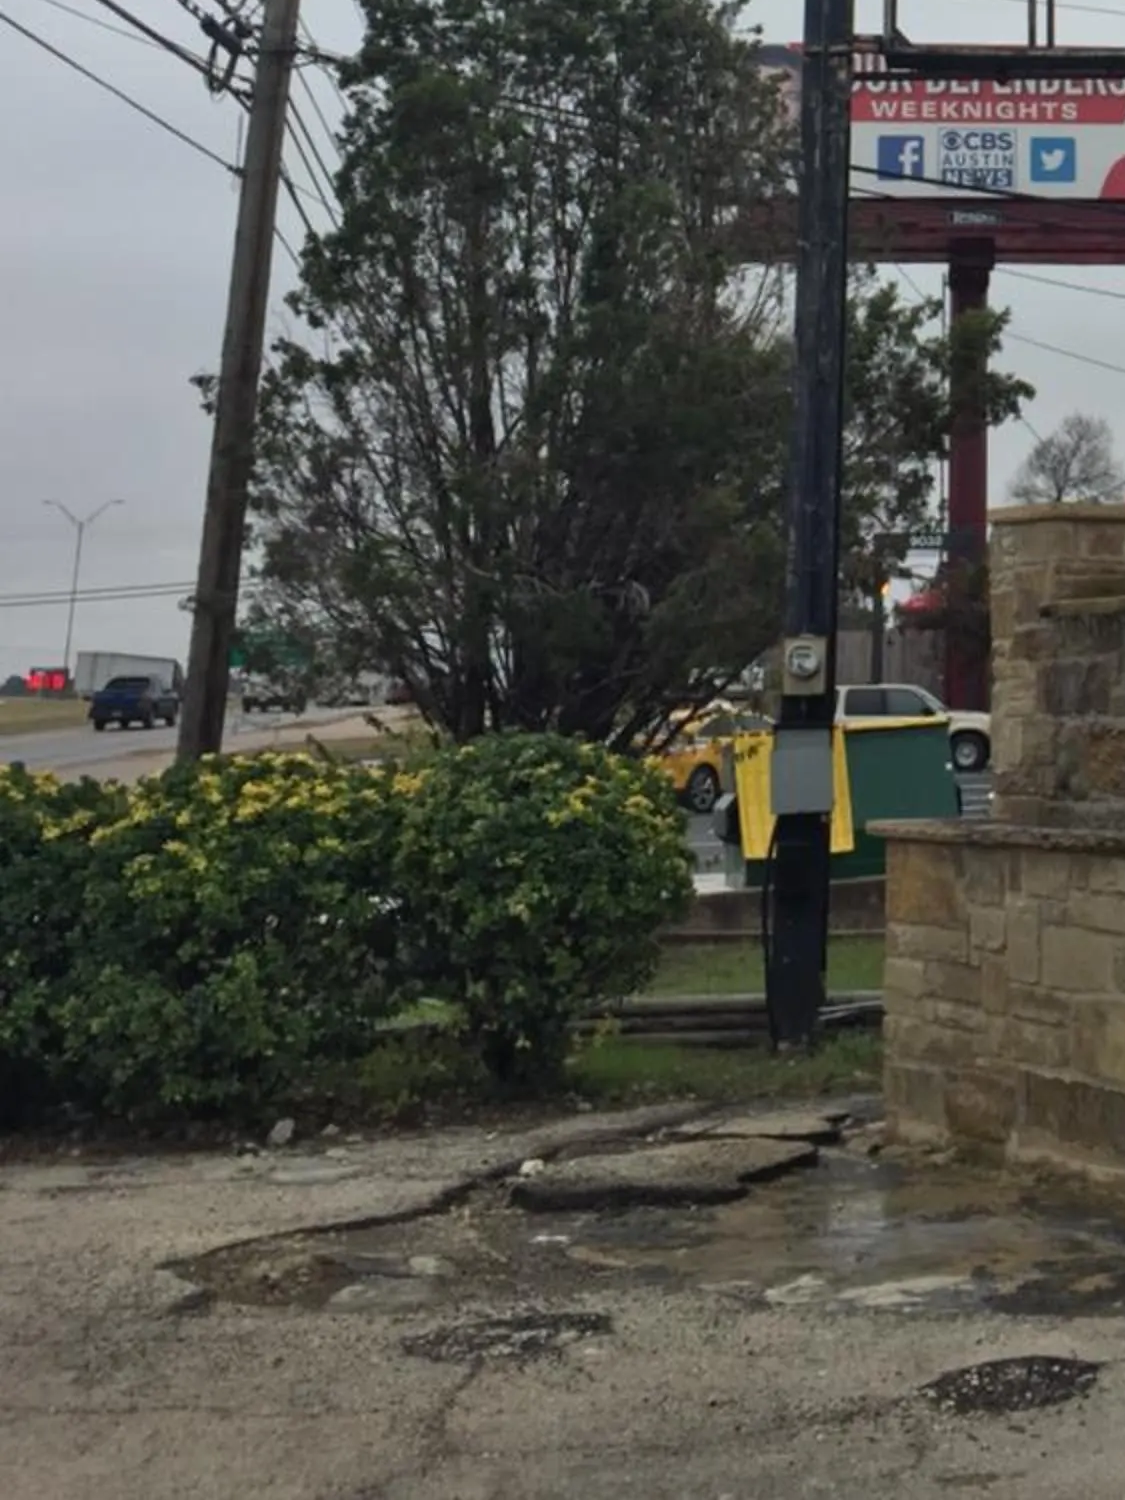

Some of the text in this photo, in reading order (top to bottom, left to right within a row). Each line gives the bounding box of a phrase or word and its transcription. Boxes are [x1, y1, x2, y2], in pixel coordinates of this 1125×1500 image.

[870, 101, 1079, 121] WEEKNIGHTS
[963, 131, 1013, 151] CBS
[943, 153, 1014, 167] AUSTIN
